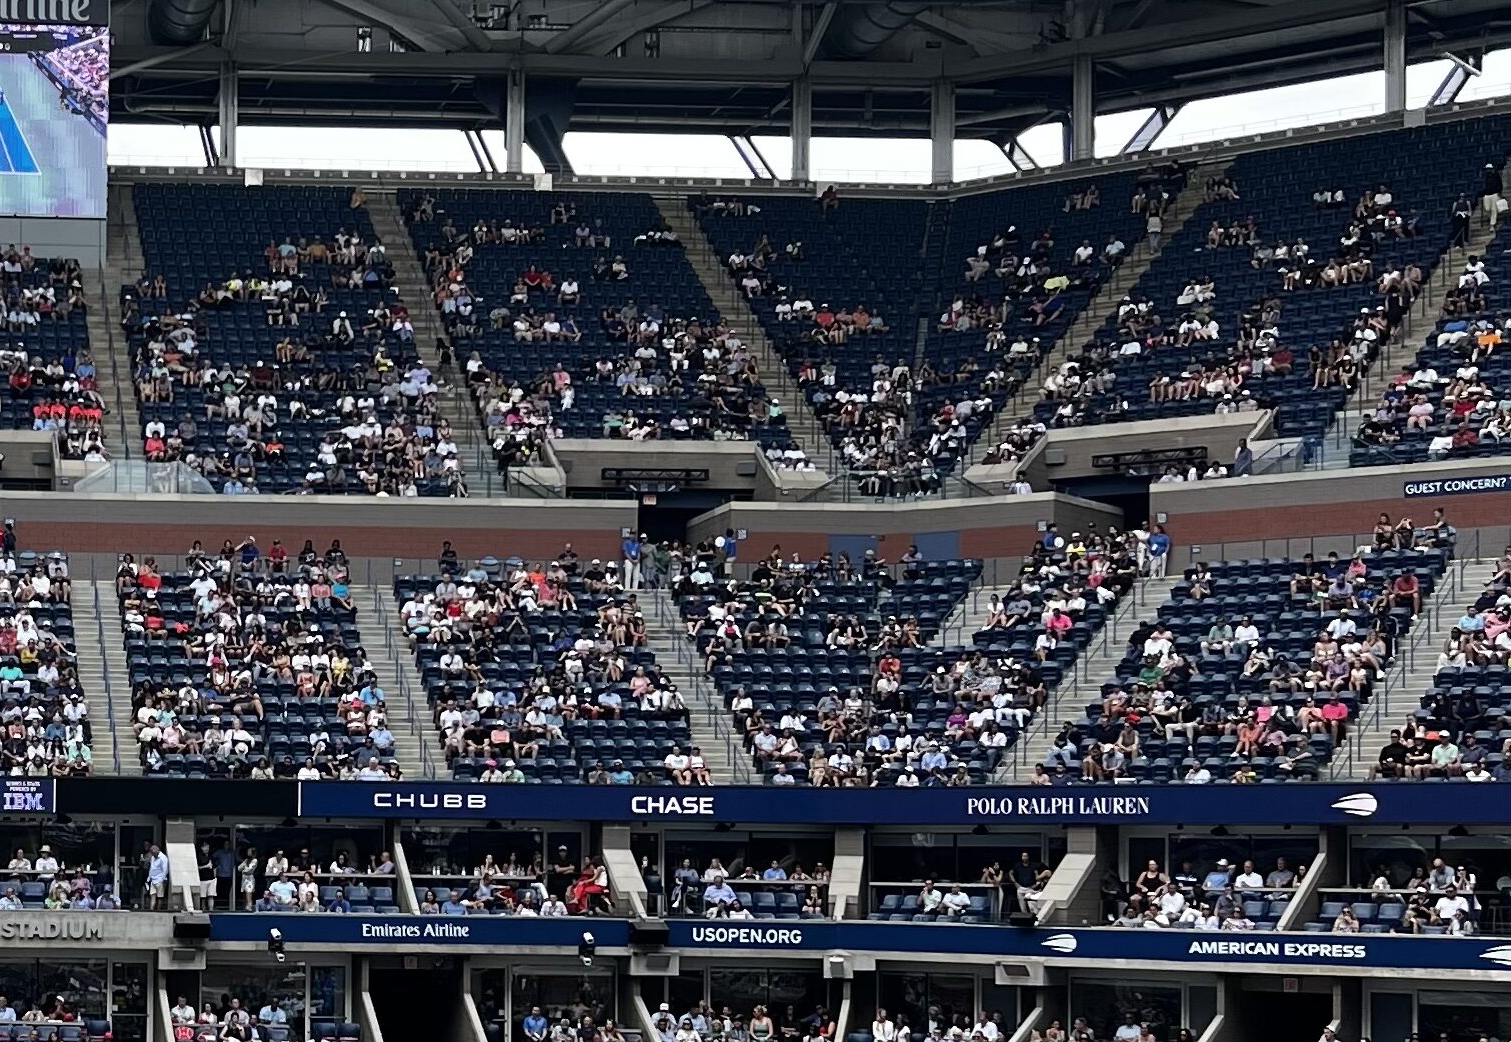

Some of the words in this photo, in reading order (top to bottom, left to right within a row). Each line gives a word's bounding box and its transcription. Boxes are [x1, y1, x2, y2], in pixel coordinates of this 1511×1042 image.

[1405, 482, 1442, 495] GUEST
[1444, 478, 1506, 492] CONCERN?
[3, 793, 43, 810] IBM
[373, 792, 487, 809] CHUBB
[631, 796, 714, 815] CHASE
[967, 798, 1012, 815] POLO
[1017, 798, 1074, 815] RALPH
[1080, 797, 1150, 815] LAUREN
[1, 921, 104, 940] STADIUM
[362, 922, 420, 937] Emirates
[423, 922, 469, 937] Airline
[692, 927, 802, 944] USOPEN.ORG
[1189, 941, 1279, 955] AMERICAN
[1284, 943, 1366, 958] EXPRESS
